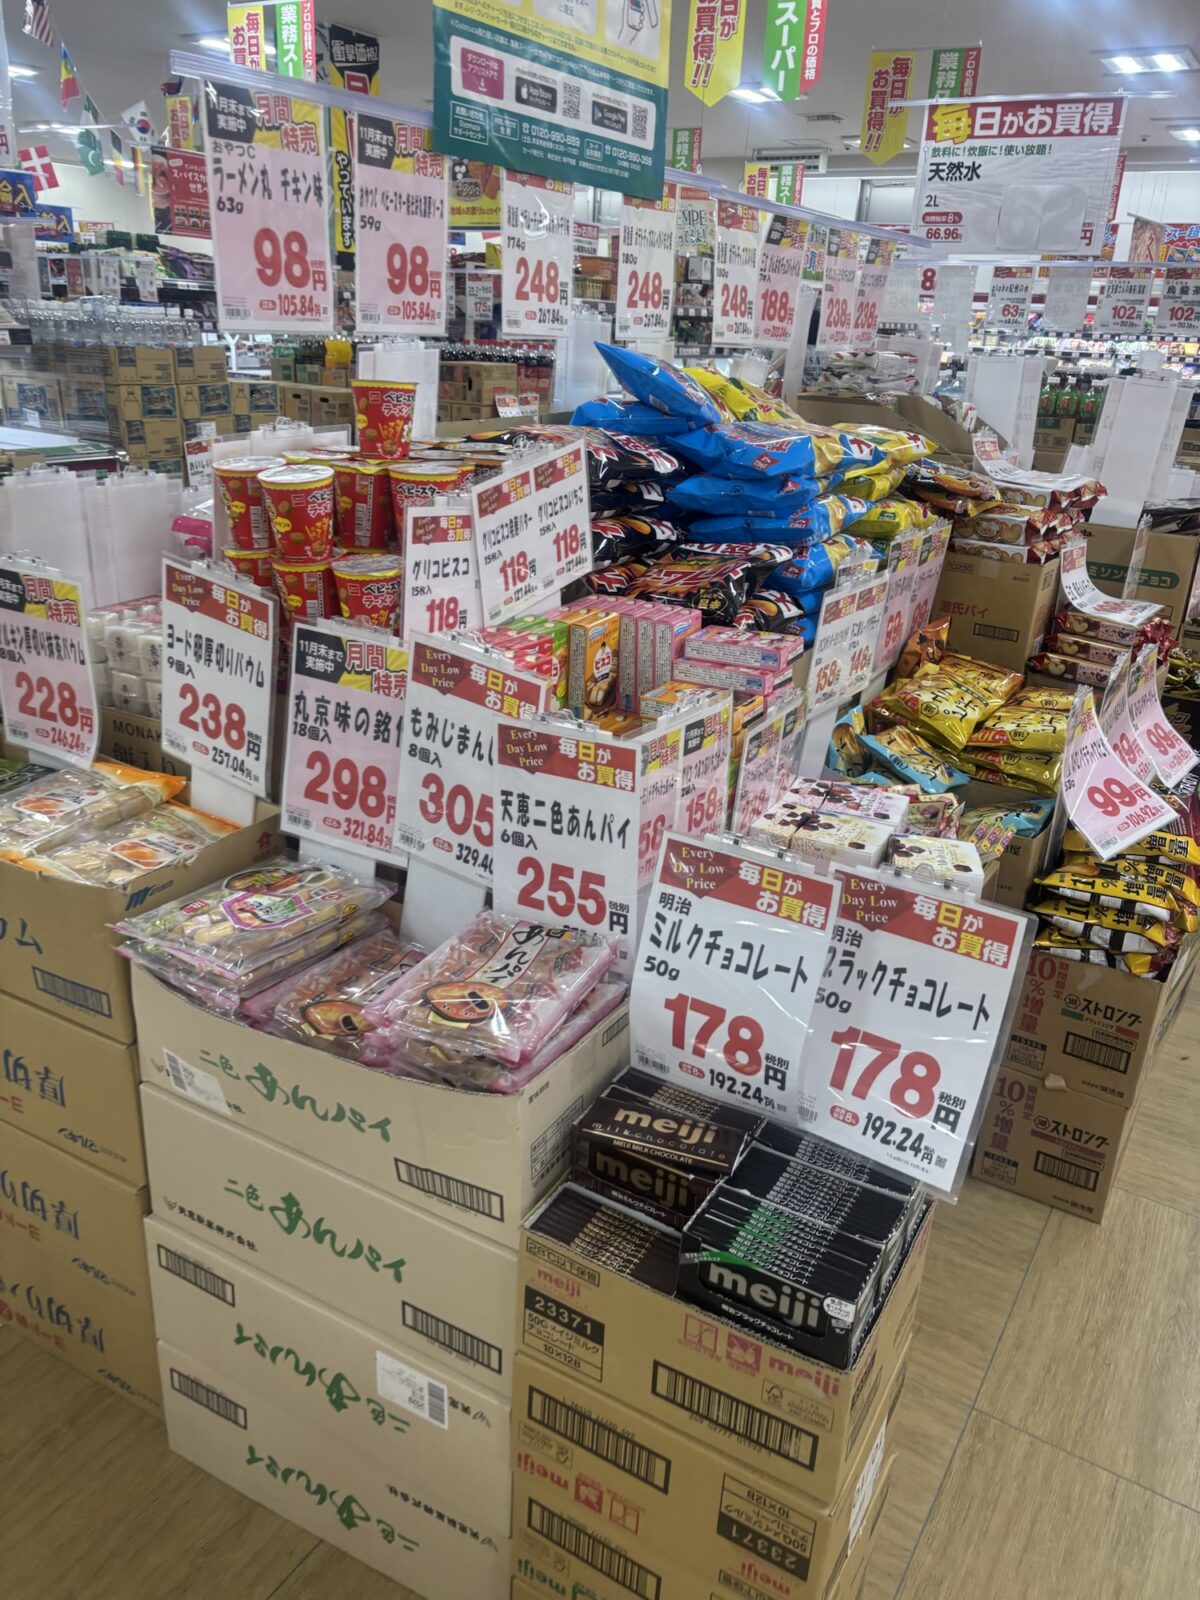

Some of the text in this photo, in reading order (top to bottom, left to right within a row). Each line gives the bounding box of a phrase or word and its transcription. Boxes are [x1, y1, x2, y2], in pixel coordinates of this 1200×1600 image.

[690, 0, 719, 88] 買得!!
[281, 122, 319, 155] 特売
[932, 101, 1115, 145] 毎日がお買得
[928, 161, 983, 182] 天然水
[216, 196, 244, 214] 63g
[925, 194, 940, 208] 2L
[360, 215, 381, 232] 59g
[926, 227, 958, 241] 66.96
[254, 227, 311, 289] 98
[507, 236, 526, 251] 174g
[386, 243, 429, 297] 98
[515, 256, 560, 304] 248
[278, 294, 315, 317] 105.84
[627, 269, 662, 310] 248
[721, 282, 749, 319] 248
[760, 287, 790, 324] 188
[402, 301, 431, 321] 105.84
[825, 297, 849, 330] 238
[853, 300, 878, 331] 238
[1001, 303, 1020, 318] 63
[1112, 304, 1137, 320] 102
[1169, 306, 1194, 321] 102
[552, 524, 581, 564] 118
[412, 556, 470, 582] グリコビスコ
[500, 550, 530, 593] 118
[211, 583, 252, 613] 毎日が
[225, 608, 269, 641] お買得
[426, 596, 460, 634] 118
[166, 623, 266, 689] ヨード卵厚切りバウム
[166, 655, 196, 679] 9個入
[299, 639, 345, 663] 11月末まで
[305, 655, 336, 675] 実施中
[345, 641, 387, 672] 月間
[426, 650, 453, 665] Every
[420, 662, 461, 678] Day Low
[432, 677, 456, 690] Price
[469, 663, 519, 696] 毎日が
[815, 657, 839, 695] 158
[15, 671, 79, 727] 228
[484, 690, 537, 722] お買得
[178, 682, 247, 752] 238
[291, 721, 333, 745] 18個入
[293, 690, 405, 749] 丸京味の銘
[506, 742, 549, 756] Day Low
[510, 729, 539, 742] Every
[558, 737, 612, 766] 毎日が
[1146, 721, 1177, 757] 99
[211, 745, 246, 777] 257.04
[408, 742, 443, 769] 8個入
[518, 756, 544, 768] Price
[303, 750, 388, 819] 298
[576, 761, 634, 792] お買得
[418, 772, 494, 848] 305
[685, 786, 719, 834] 158
[1086, 776, 1139, 818] 99
[500, 788, 632, 850] 天恵二色あんパイ
[1128, 803, 1157, 829] 106.92
[343, 817, 386, 848] 321.84
[500, 829, 539, 851] 6個入
[682, 847, 715, 860] Every
[673, 863, 725, 878] Day Low
[686, 878, 717, 890] Price
[738, 861, 803, 894] 毎日が
[850, 878, 888, 893] Every
[516, 856, 608, 926] 255
[658, 892, 693, 917] 明治
[842, 894, 899, 910] Day Low
[755, 890, 827, 929] お買得
[855, 911, 889, 924] Price
[912, 895, 985, 934] 毎日が
[649, 911, 809, 993] ミルクチョコレート
[831, 924, 864, 949] 明治
[931, 925, 1009, 967] お買得
[643, 955, 681, 981] 50g
[814, 986, 852, 1014] 50g
[1080, 997, 1144, 1028] ストロング
[664, 992, 765, 1077] 178
[765, 1052, 790, 1070] 税別
[828, 1025, 943, 1120] 178
[709, 1068, 764, 1106] 192.24
[938, 1090, 967, 1111] 税別
[614, 1108, 719, 1145] meiji
[861, 1111, 925, 1158] 192.24
[1050, 1118, 1110, 1150] ストロング
[596, 1151, 690, 1209] meiji
[537, 1268, 582, 1299] meiji
[708, 1264, 822, 1328] meiji
[534, 1296, 593, 1336] 23371
[769, 1351, 841, 1399] meiji
[516, 1452, 569, 1492] meiji
[730, 1523, 798, 1570] 23371
[739, 1562, 791, 1597] meiji
